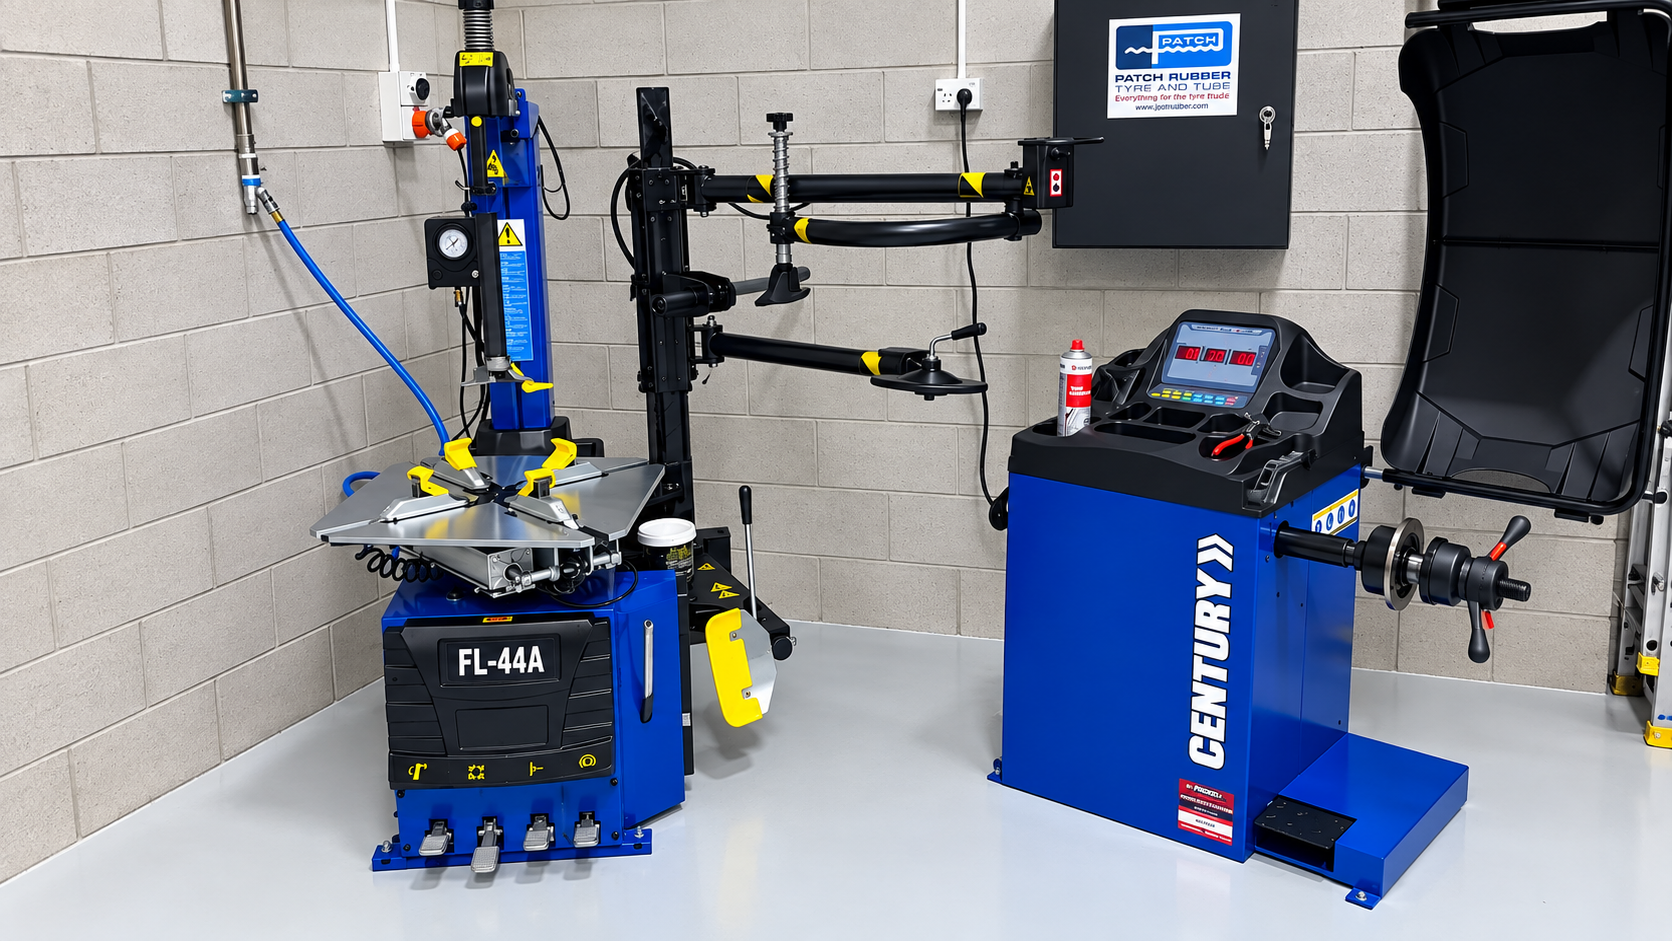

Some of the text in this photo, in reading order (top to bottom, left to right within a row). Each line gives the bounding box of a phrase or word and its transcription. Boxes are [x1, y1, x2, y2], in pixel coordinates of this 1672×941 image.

[1162, 36, 1216, 46] PATCH
[1115, 71, 1231, 83] PATCH RUBBER
[1115, 81, 1231, 93] TYRE AND TUBE
[1160, 93, 1171, 101] for
[1173, 93, 1187, 101] the
[458, 645, 545, 676] FL-44A
[1188, 567, 1232, 770] CENTURY
